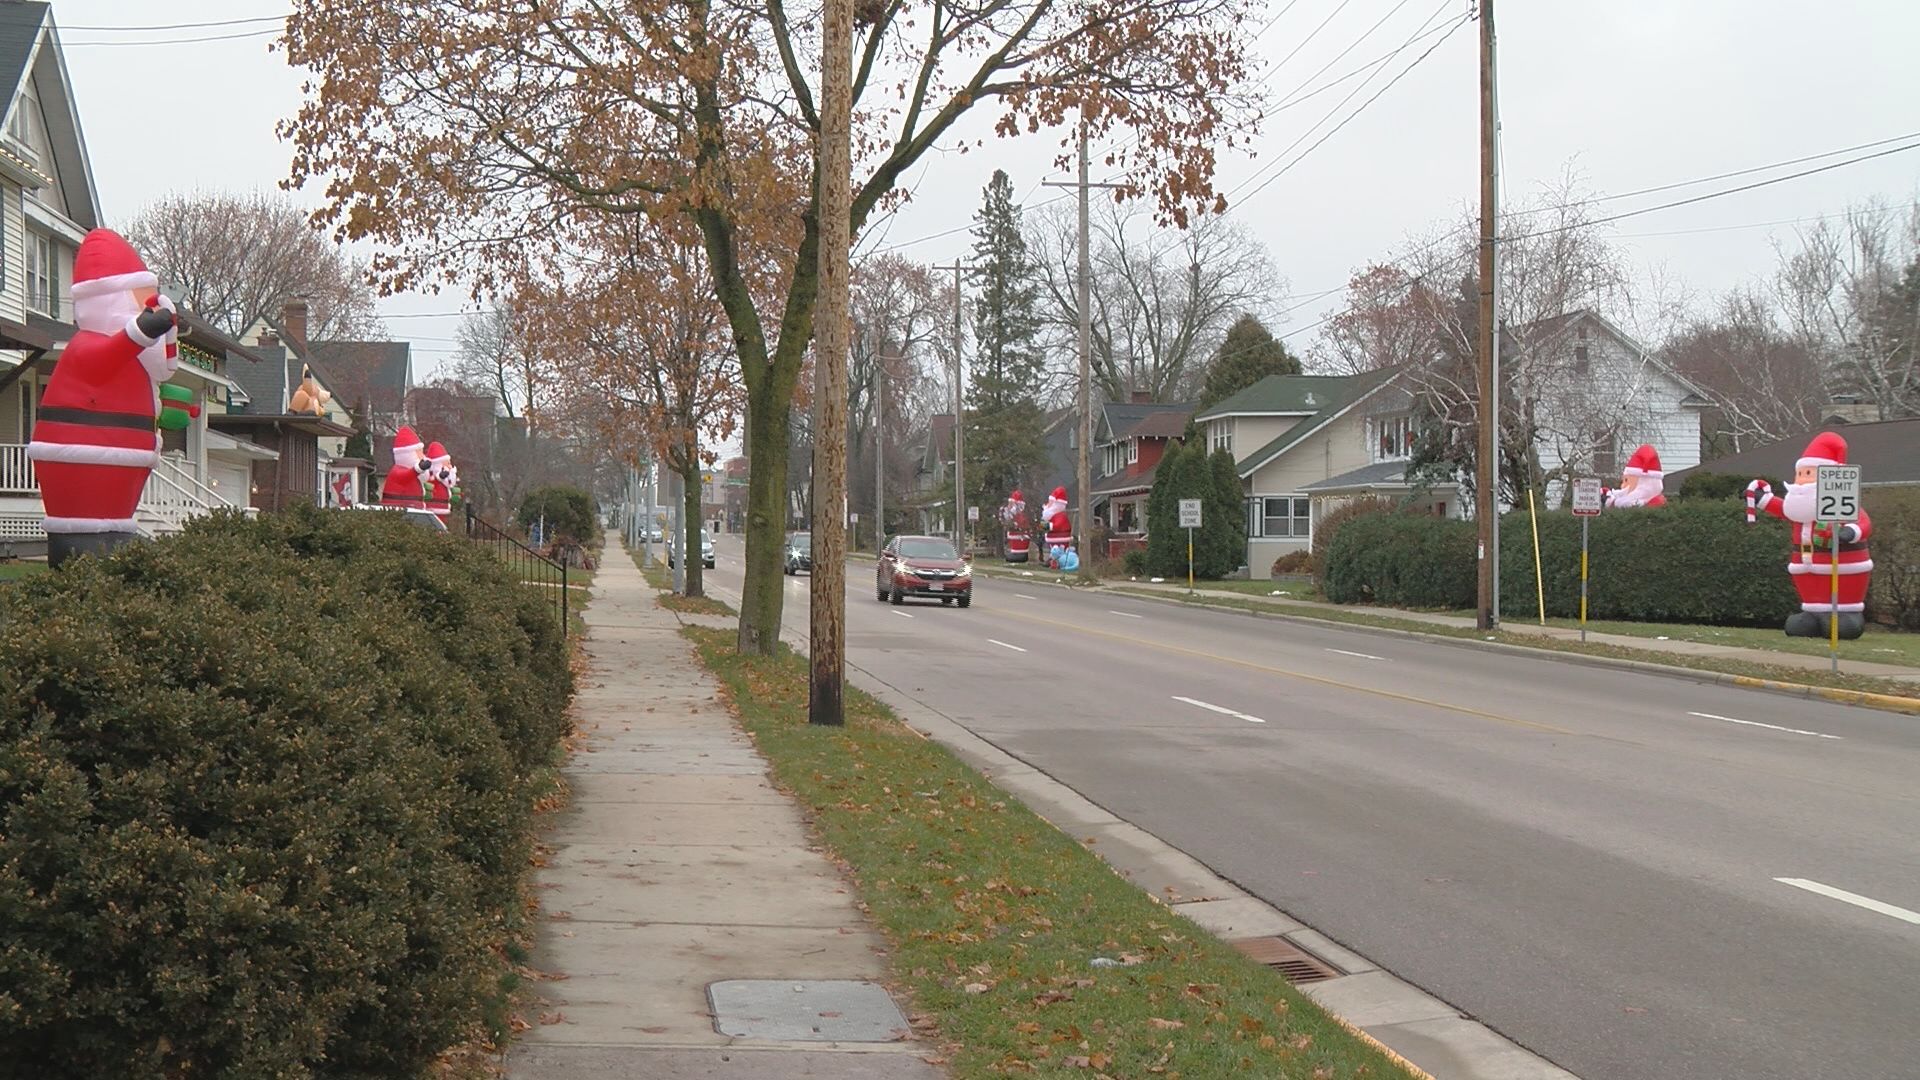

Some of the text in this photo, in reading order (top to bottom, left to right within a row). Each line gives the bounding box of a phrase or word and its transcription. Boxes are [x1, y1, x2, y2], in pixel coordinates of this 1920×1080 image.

[1821, 470, 1857, 479] SPEED
[1824, 482, 1853, 491] LIMIT
[1821, 496, 1855, 516] 25
